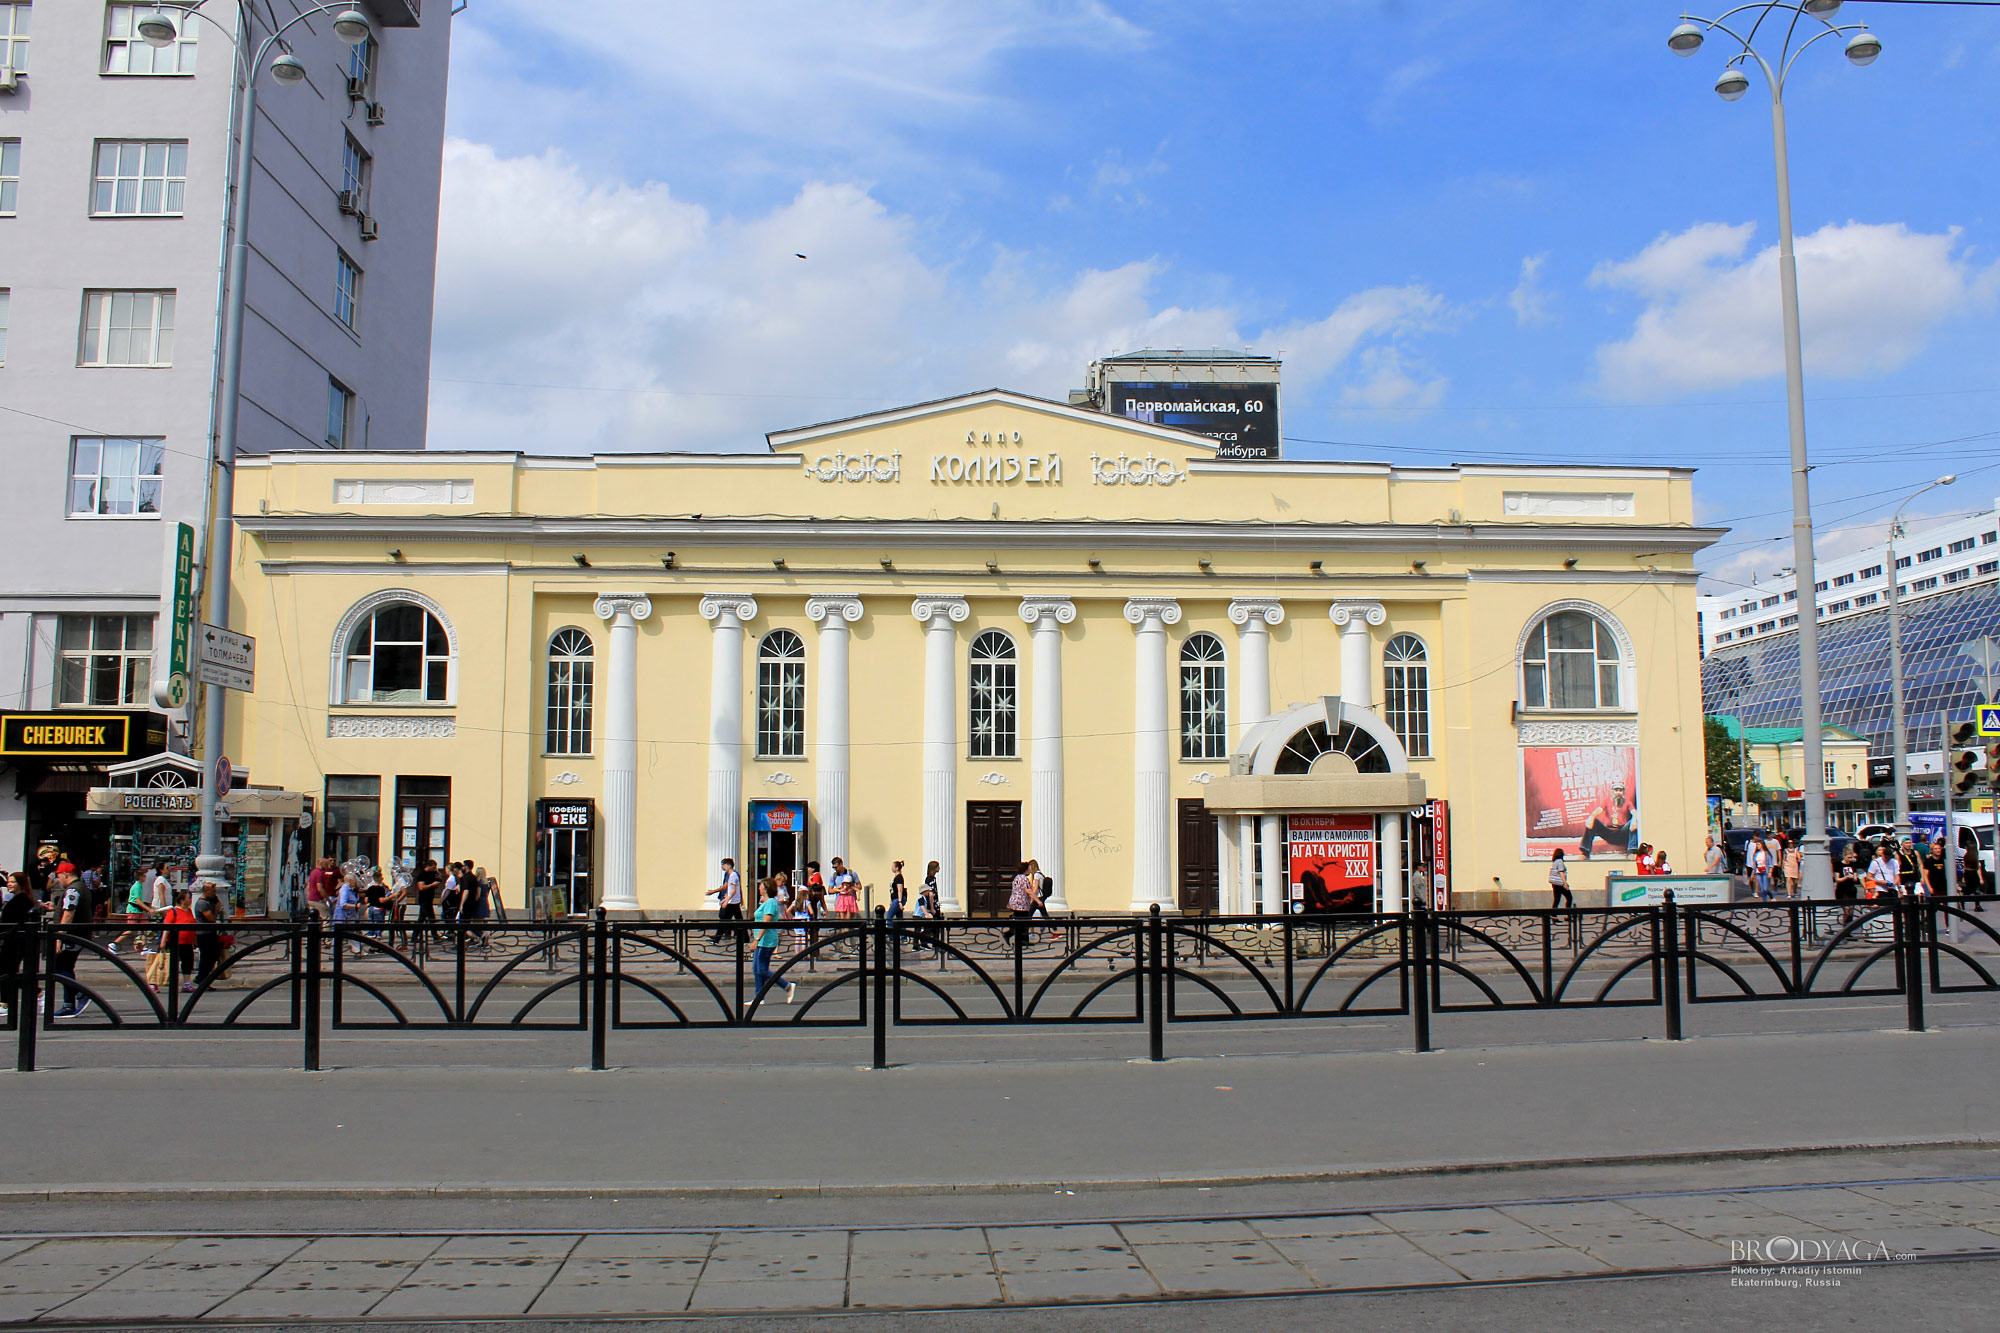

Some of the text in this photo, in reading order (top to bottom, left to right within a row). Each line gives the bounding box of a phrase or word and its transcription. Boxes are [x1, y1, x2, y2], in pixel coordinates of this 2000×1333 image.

[1125, 398, 1263, 415] Первомайская, 60
[930, 451, 1061, 482] КОЛИЗЕЙ
[174, 533, 190, 663] АПТЕКА
[220, 634, 239, 646] улица
[209, 647, 248, 664] ТОЛМАЧЕВА
[23, 726, 106, 745] CHEBUREK
[124, 794, 194, 809] РОСПЕЧАТЬ
[560, 814, 588, 825] ЕКБ
[1292, 829, 1369, 841] ВАДИМ САМОЙЛОВ
[1291, 844, 1369, 858] АГАТА КРИСТИ
